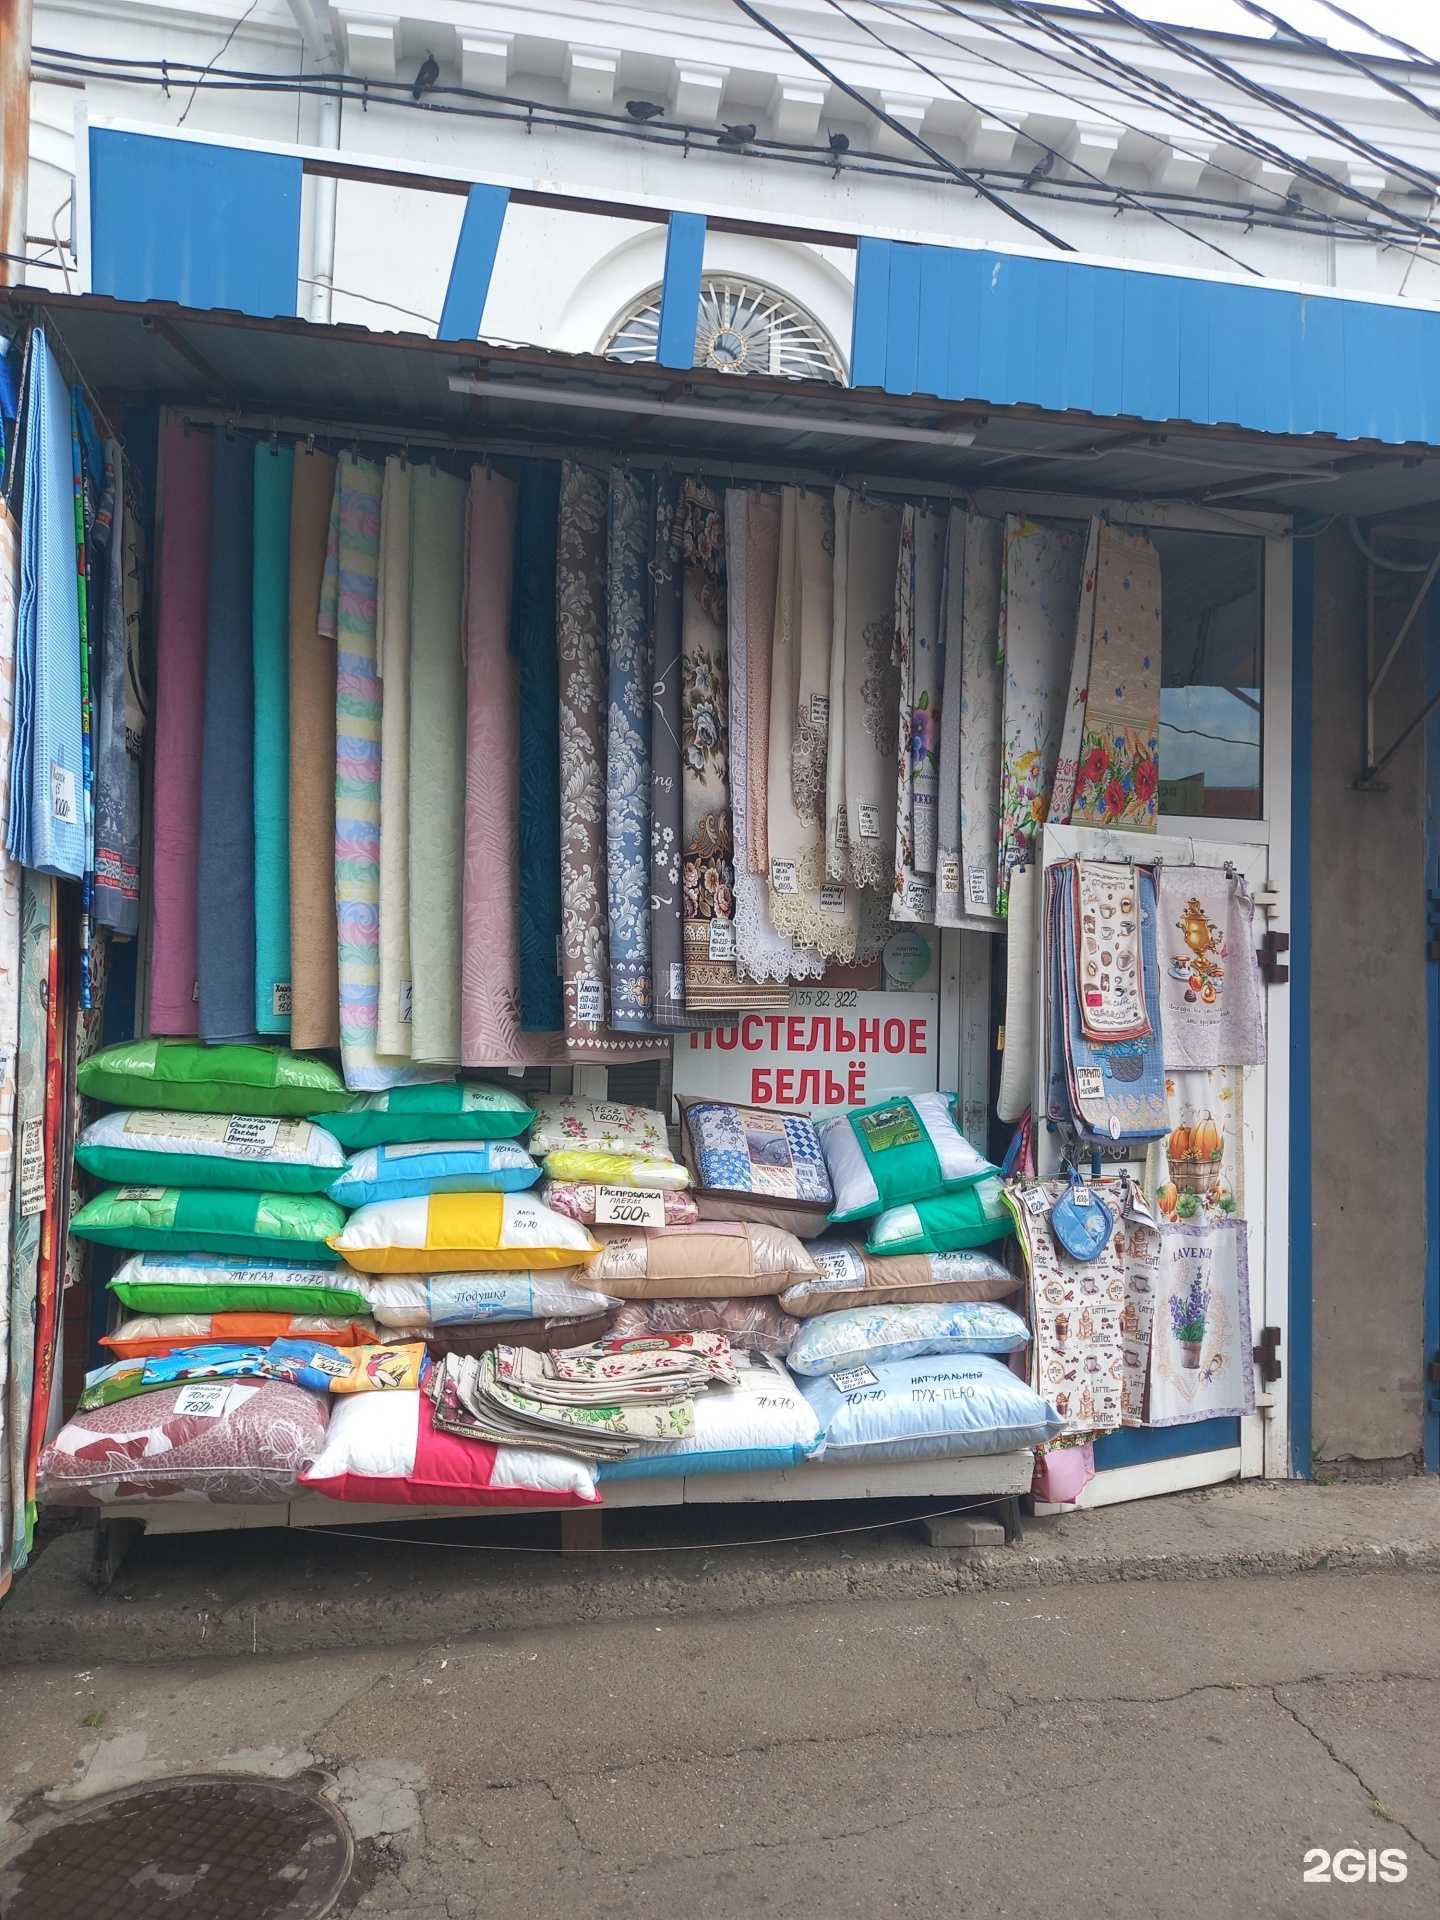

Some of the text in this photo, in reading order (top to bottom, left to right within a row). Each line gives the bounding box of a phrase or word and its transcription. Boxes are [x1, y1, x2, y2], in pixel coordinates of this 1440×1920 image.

[689, 1015, 927, 1054] ПОСТЕЛЬНОЕ
[751, 1061, 866, 1105] БЕЛЬЁ
[453, 1290, 507, 1305] Подушка
[911, 1371, 983, 1385] НАТУРАЛЬНЫЙ
